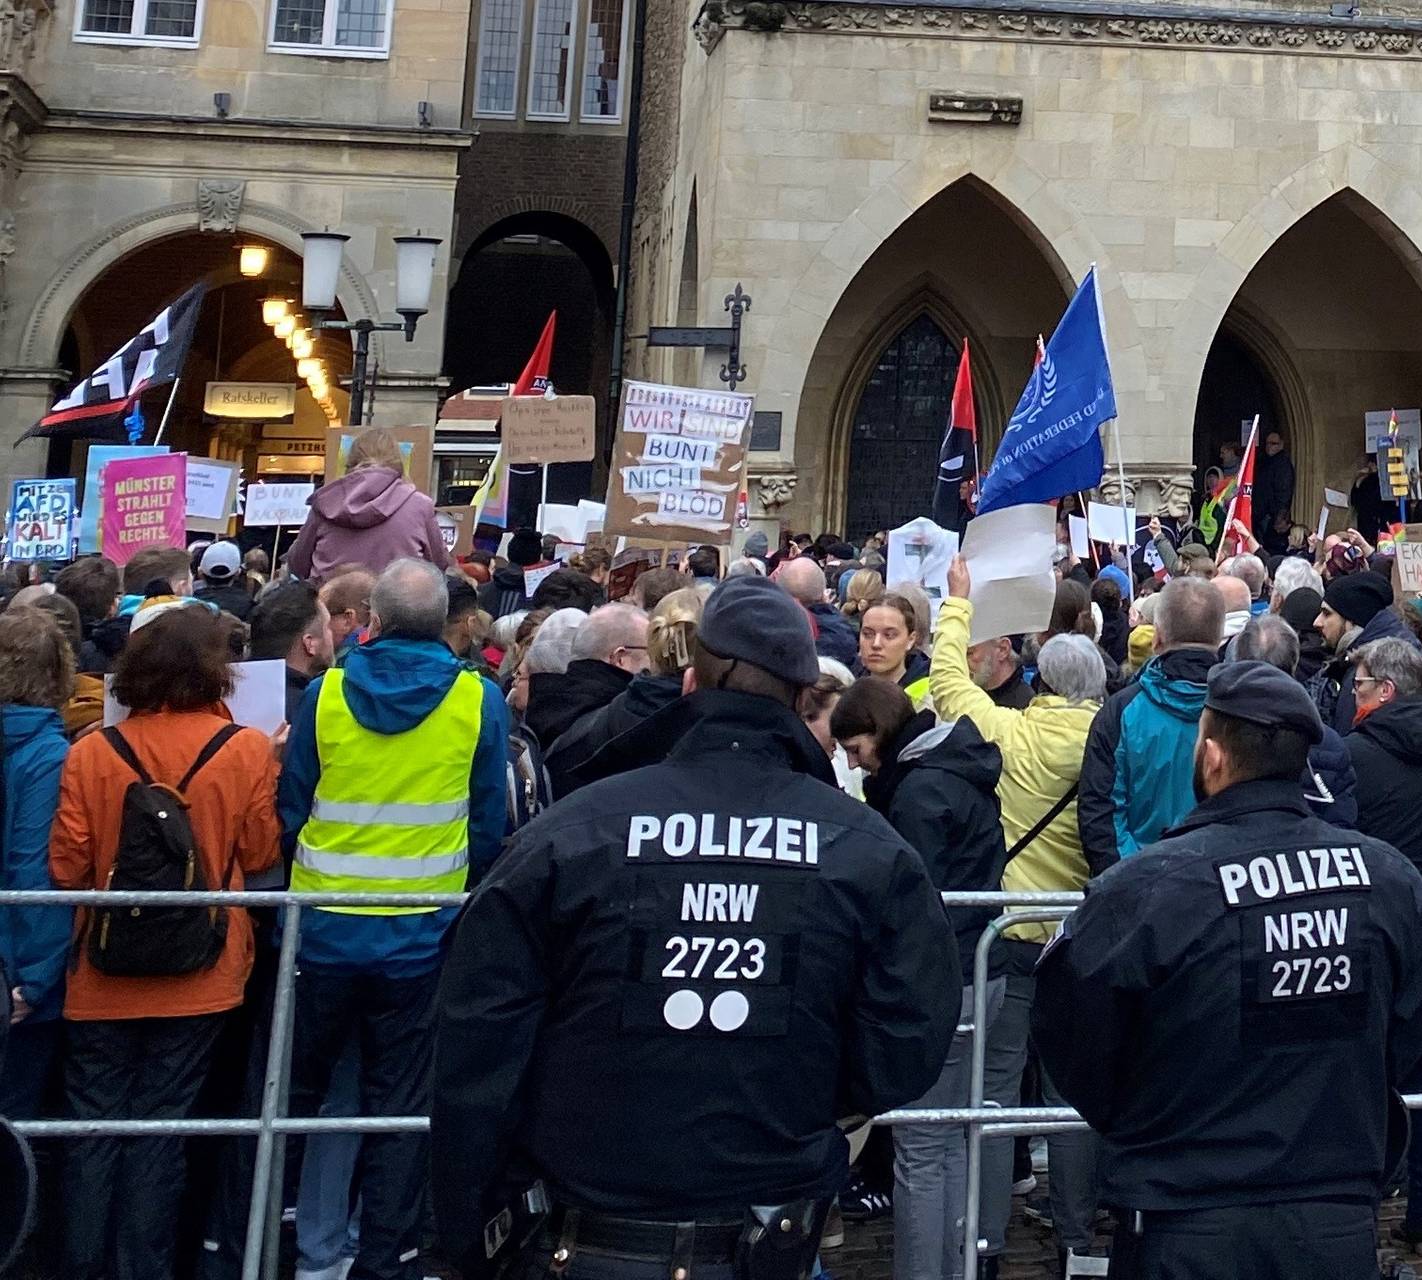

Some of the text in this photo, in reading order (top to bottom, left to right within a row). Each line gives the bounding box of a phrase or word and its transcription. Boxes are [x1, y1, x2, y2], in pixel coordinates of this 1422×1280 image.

[222, 390, 279, 405] Ratskeller
[630, 409, 739, 439] WIR SIND
[648, 438, 709, 463] BUNT
[115, 475, 176, 496] MÜNSTER
[628, 467, 695, 490] NICHT
[117, 492, 173, 513] STRAHLT
[663, 489, 723, 516] BLÖD
[15, 522, 64, 542] KALT
[124, 510, 165, 528] GEGEN
[119, 526, 170, 544] RECHTS.
[627, 813, 818, 864] POLIZEI
[1219, 847, 1371, 904] POLIZEI
[681, 883, 759, 922] NRW
[1264, 908, 1348, 952] NRW
[662, 936, 766, 979] 2723
[1272, 955, 1351, 997] 2723
